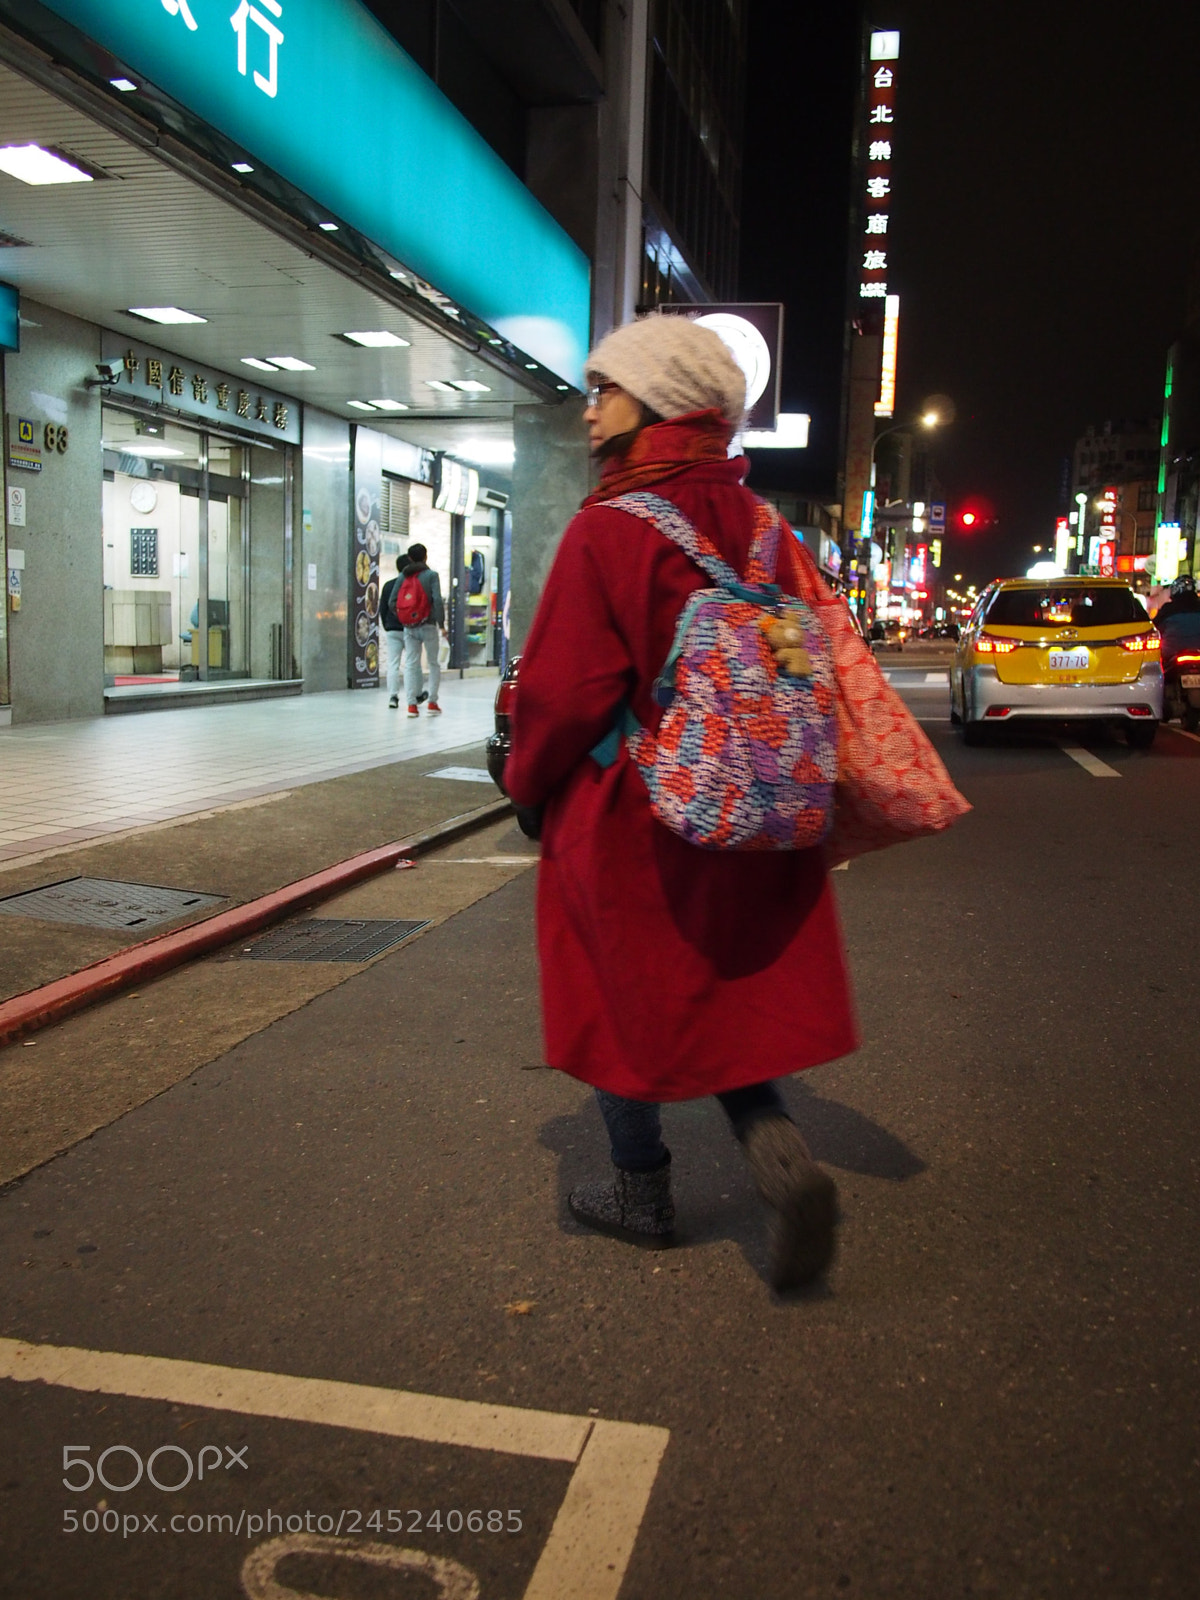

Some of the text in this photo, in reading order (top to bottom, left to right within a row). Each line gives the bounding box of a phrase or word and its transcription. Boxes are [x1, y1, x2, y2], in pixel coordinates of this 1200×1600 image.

[863, 66, 894, 271] 台北樂客商旅
[44, 423, 68, 455] 83
[1050, 656, 1088, 668] 377-7C
